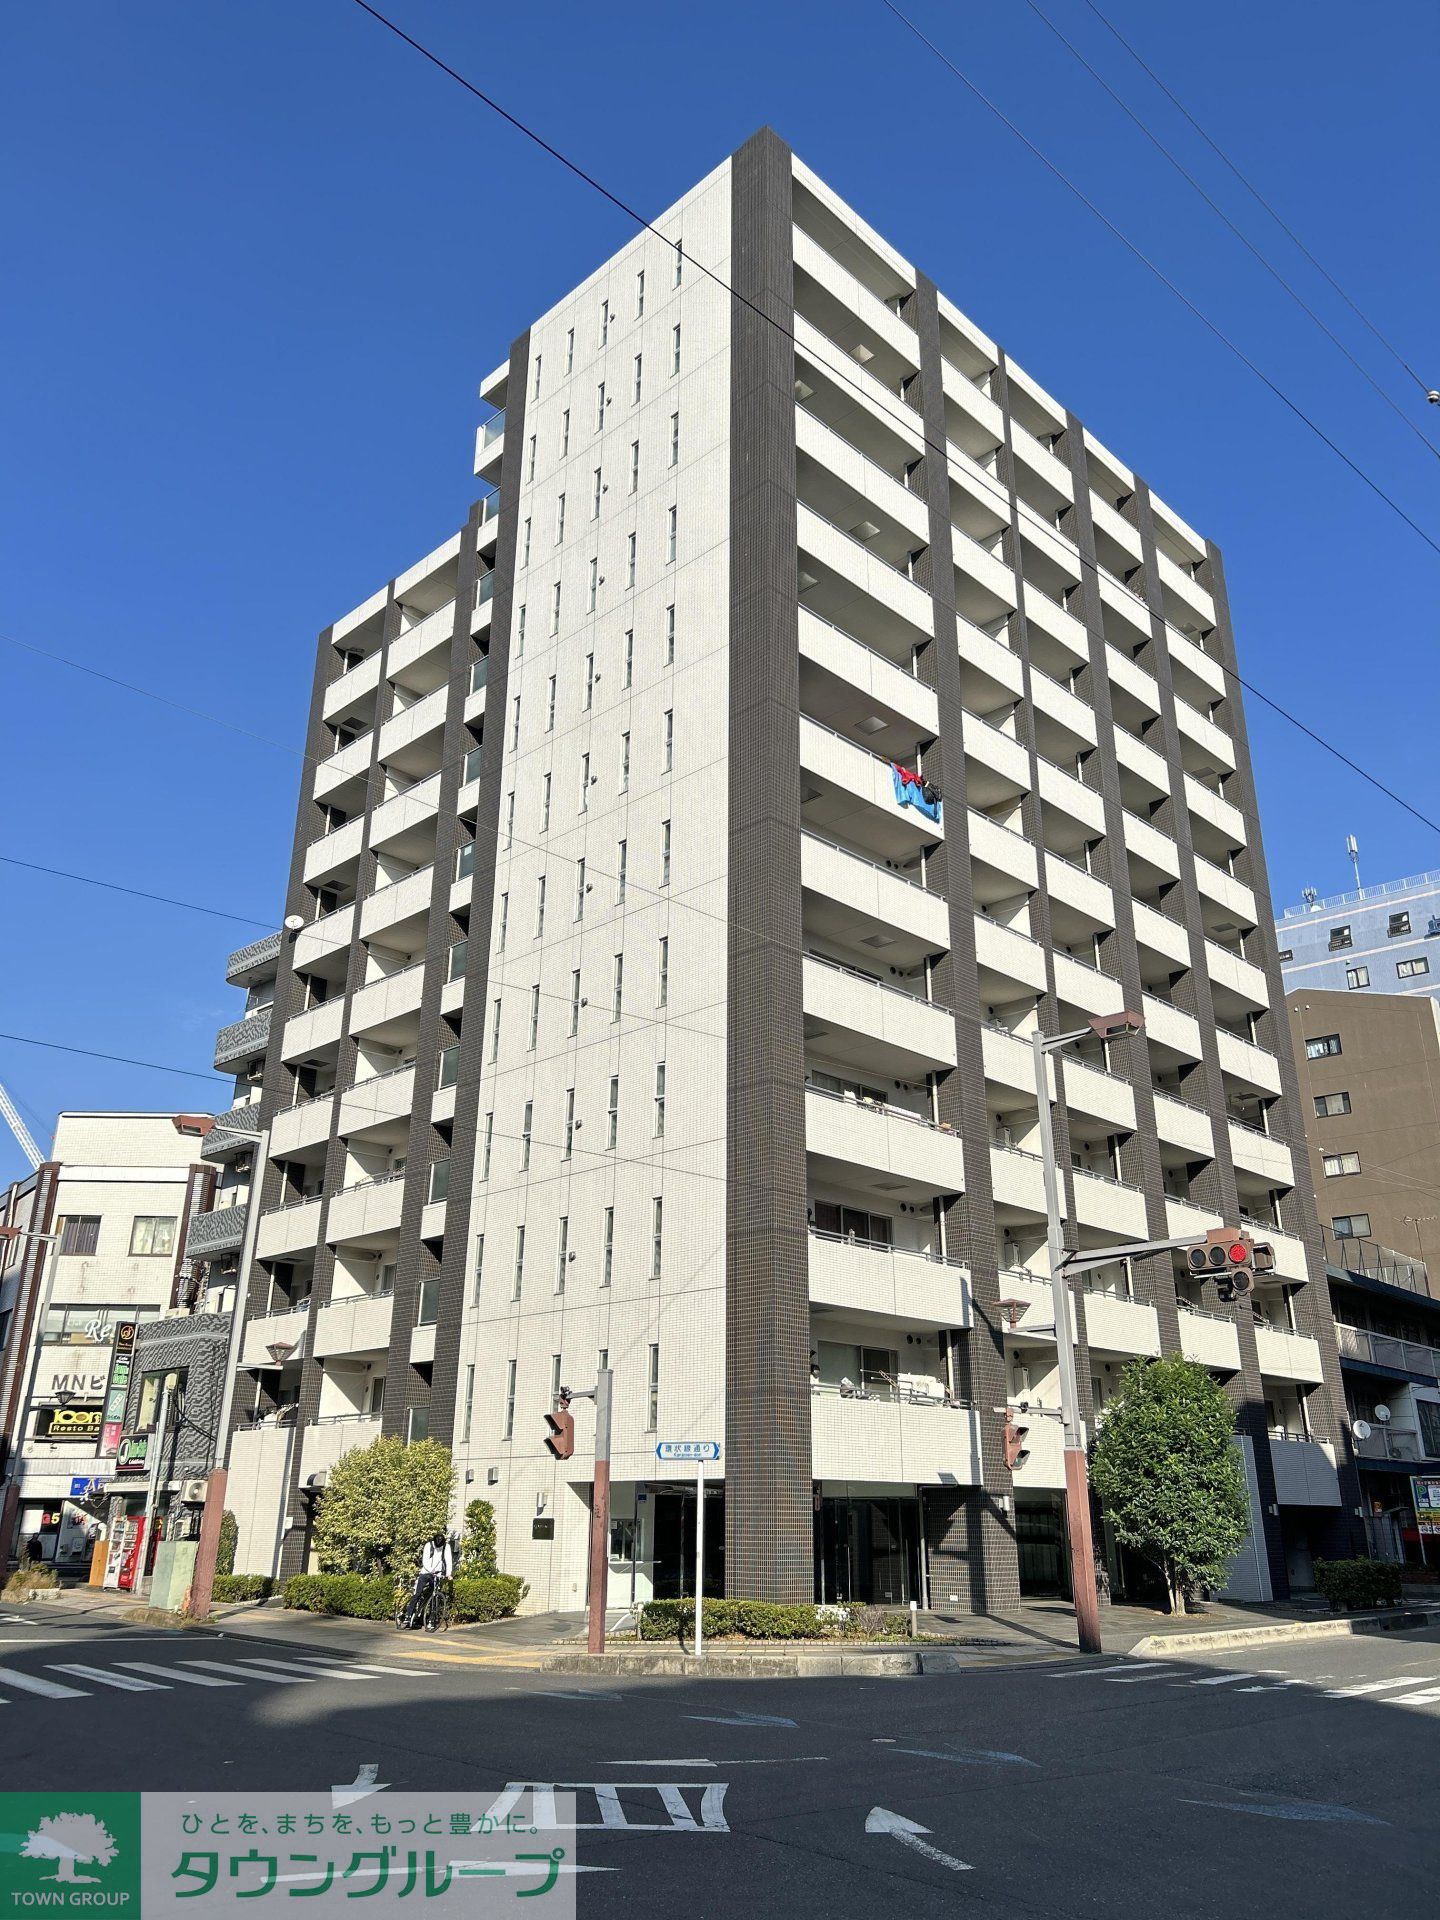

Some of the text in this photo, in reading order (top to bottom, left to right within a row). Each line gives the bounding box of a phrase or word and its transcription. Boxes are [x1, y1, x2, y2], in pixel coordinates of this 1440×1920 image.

[665, 1444, 709, 1452] 環状線通り
